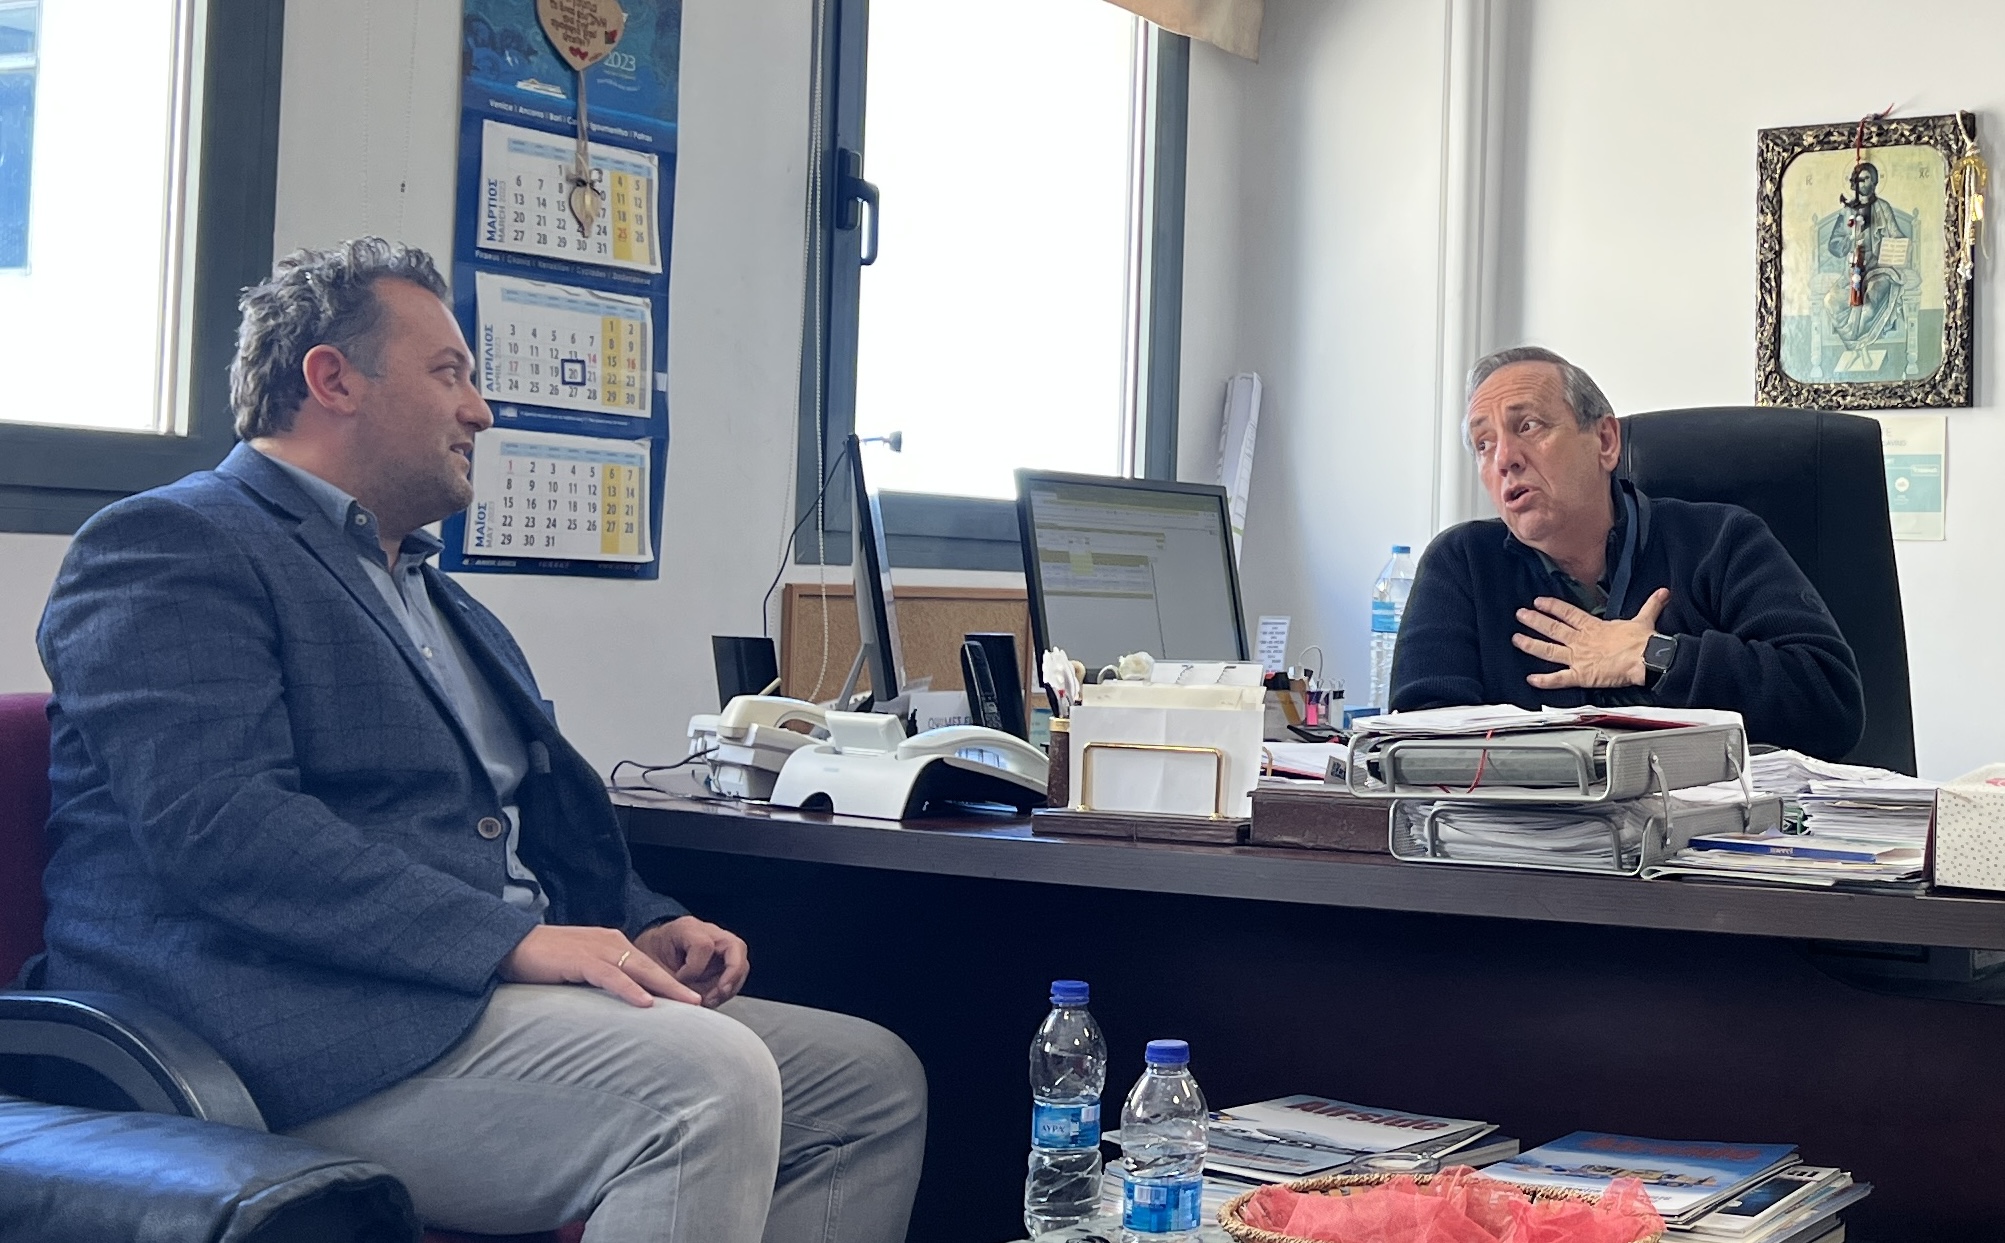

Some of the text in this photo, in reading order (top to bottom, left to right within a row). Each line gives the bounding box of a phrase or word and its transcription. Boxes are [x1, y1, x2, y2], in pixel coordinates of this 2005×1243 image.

[603, 51, 636, 71] 2023
[558, 165, 640, 190] 1 4 5
[516, 175, 642, 208] 6 7 8 0 11 12
[486, 178, 498, 241] ΜΑΡΤΙΟΣ
[514, 193, 643, 225] 13 14 15 7 18 19
[513, 211, 525, 223] 20
[536, 215, 547, 226] 21
[556, 219, 566, 230] 22
[596, 225, 608, 236] 24
[617, 228, 627, 239] 25
[635, 231, 644, 243] 26
[513, 230, 608, 254] 27 28 29 30 31
[510, 324, 634, 352] 3 4 5 6 7 8 9
[610, 321, 634, 335] 1 2
[484, 324, 494, 392] ΑΠΡΙΛΙΟΣ
[509, 342, 519, 355] 10
[530, 345, 539, 357] 11
[549, 348, 559, 360] 12
[587, 353, 597, 364] 14
[607, 355, 617, 367] 15
[626, 358, 636, 369] 16
[509, 361, 635, 387] 17 18 19 20 21 22 23
[508, 379, 636, 404] 24 25 26 27 28 29 30
[508, 460, 633, 482] 1 2 3 4 5 6 7
[506, 478, 635, 499] 8 9 10 11 12 13 14
[503, 497, 634, 516] 15 16 17 18 19 20 21
[474, 501, 487, 548] ΜΑΪΟΣ
[502, 515, 634, 533] 22 23 24 25 26 27 28
[501, 534, 555, 547] 29 30 31
[1285, 1100, 1449, 1130] Airside
